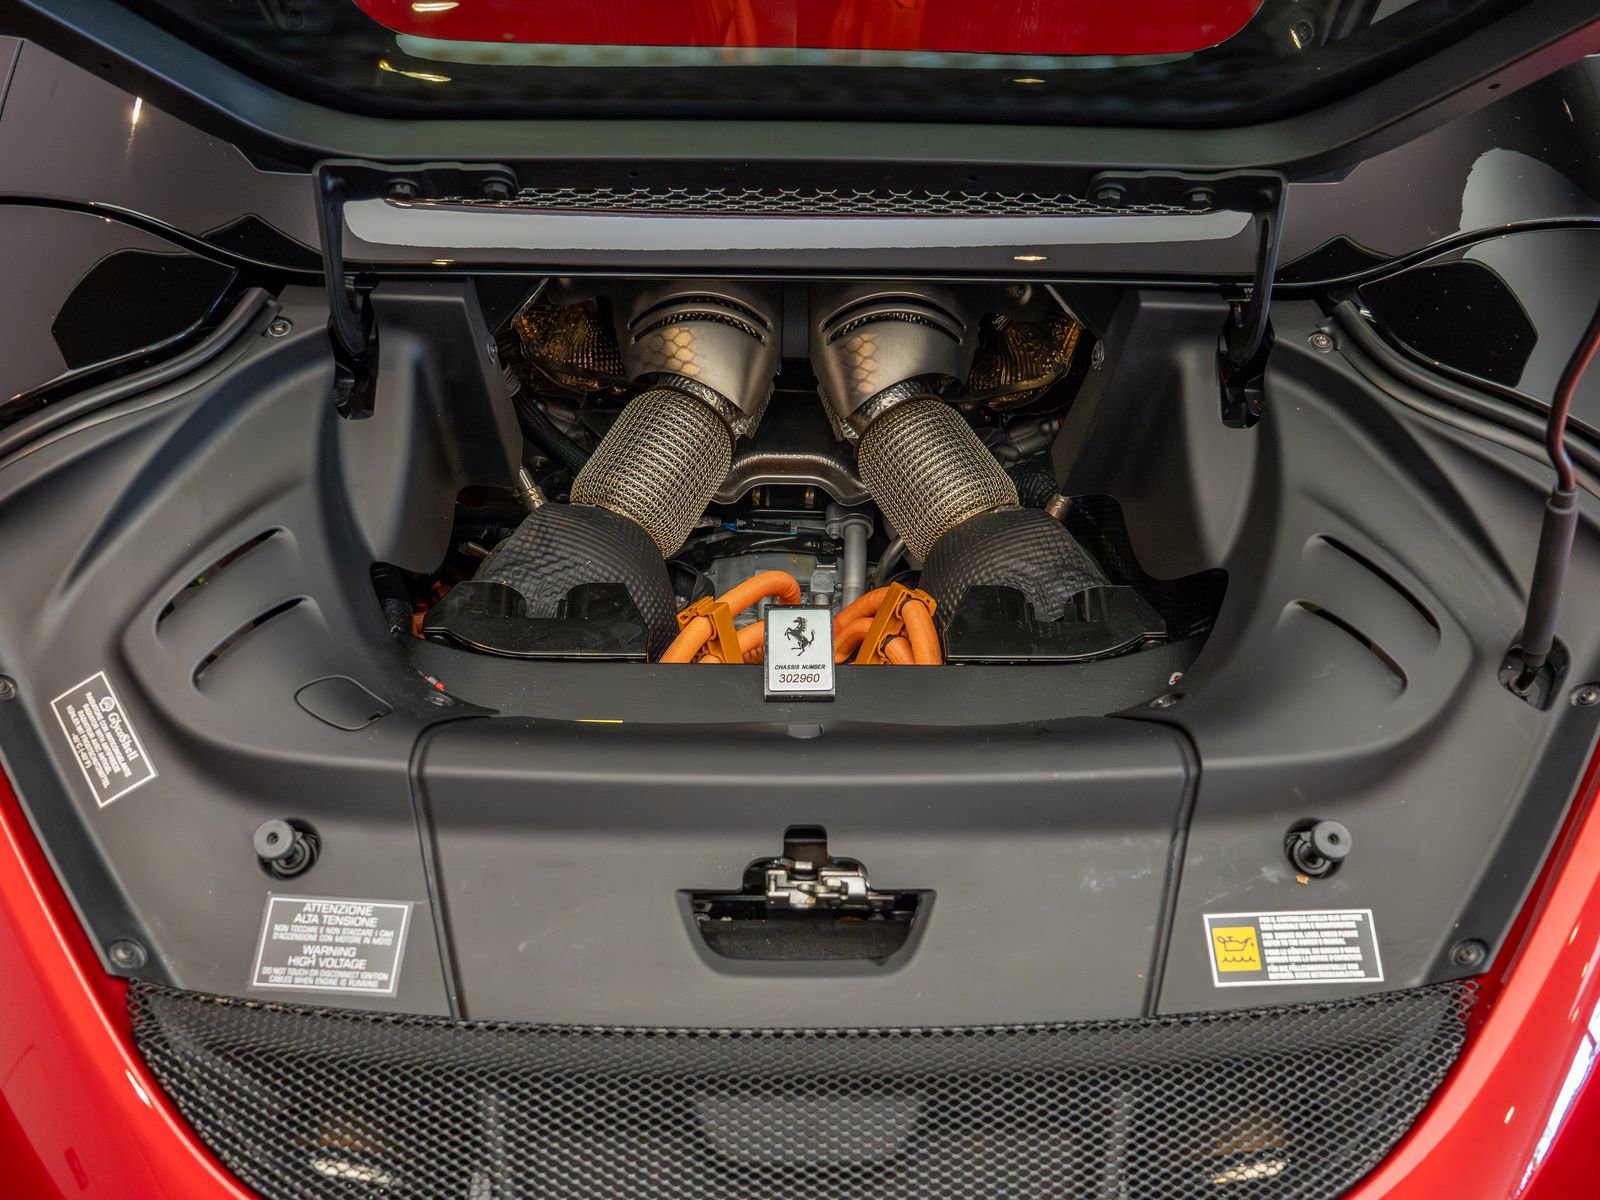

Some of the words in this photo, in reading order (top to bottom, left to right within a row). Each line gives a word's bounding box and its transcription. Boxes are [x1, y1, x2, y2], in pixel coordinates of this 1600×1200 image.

[779, 674, 820, 683] 302960
[106, 711, 139, 762] GlycoShell
[303, 902, 374, 916] ATTENZIONE
[294, 913, 320, 924] ALTA
[321, 914, 378, 928] TENSIONE
[274, 924, 289, 932] NON
[302, 944, 357, 958] WARNING
[288, 956, 316, 967] HIGH
[318, 957, 367, 970] VOLTAGE
[273, 967, 286, 975] NOT
